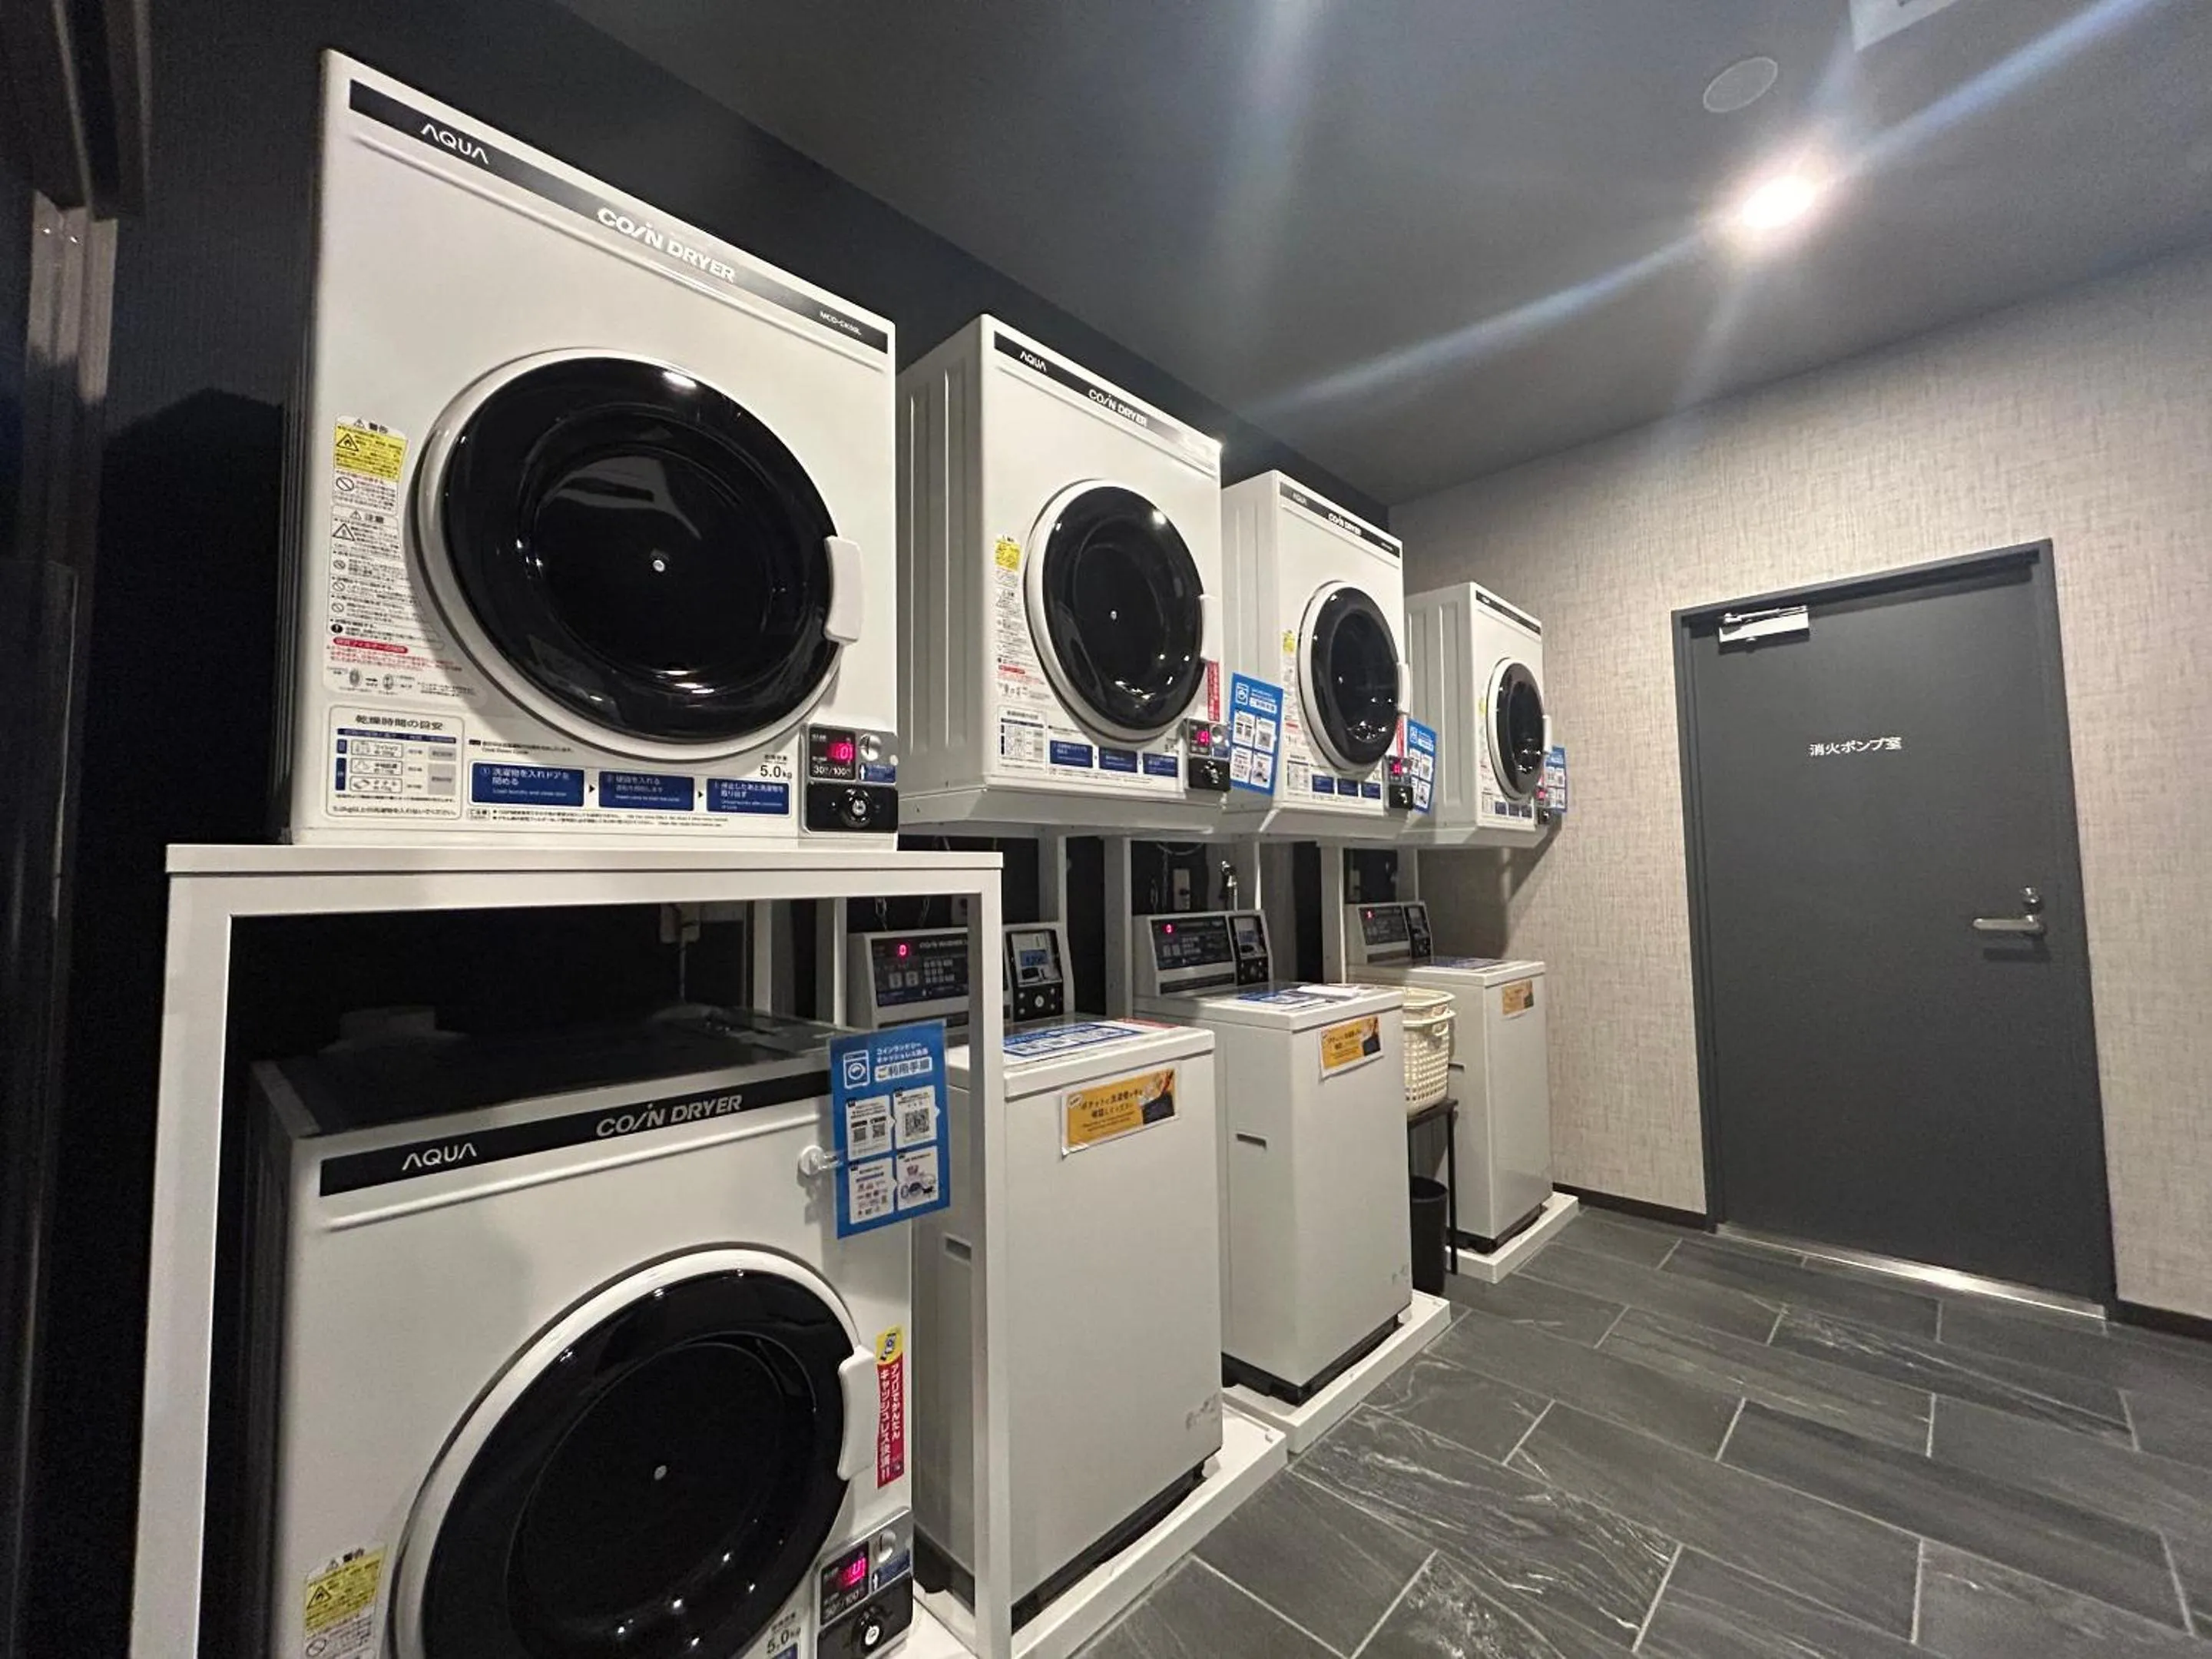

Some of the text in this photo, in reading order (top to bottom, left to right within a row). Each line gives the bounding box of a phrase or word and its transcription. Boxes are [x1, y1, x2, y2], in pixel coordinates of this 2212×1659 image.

[420, 123, 489, 164] AQUA
[598, 207, 736, 283] COIN DRYER
[1019, 350, 1048, 373] AQUA
[1088, 388, 1148, 428] COIN DRYER
[355, 714, 444, 730] 乾燥時間の目安
[1809, 736, 1902, 757] 消火ポンプ室
[595, 1094, 743, 1138] COIN DRYER
[402, 1144, 478, 1171] AQUA
